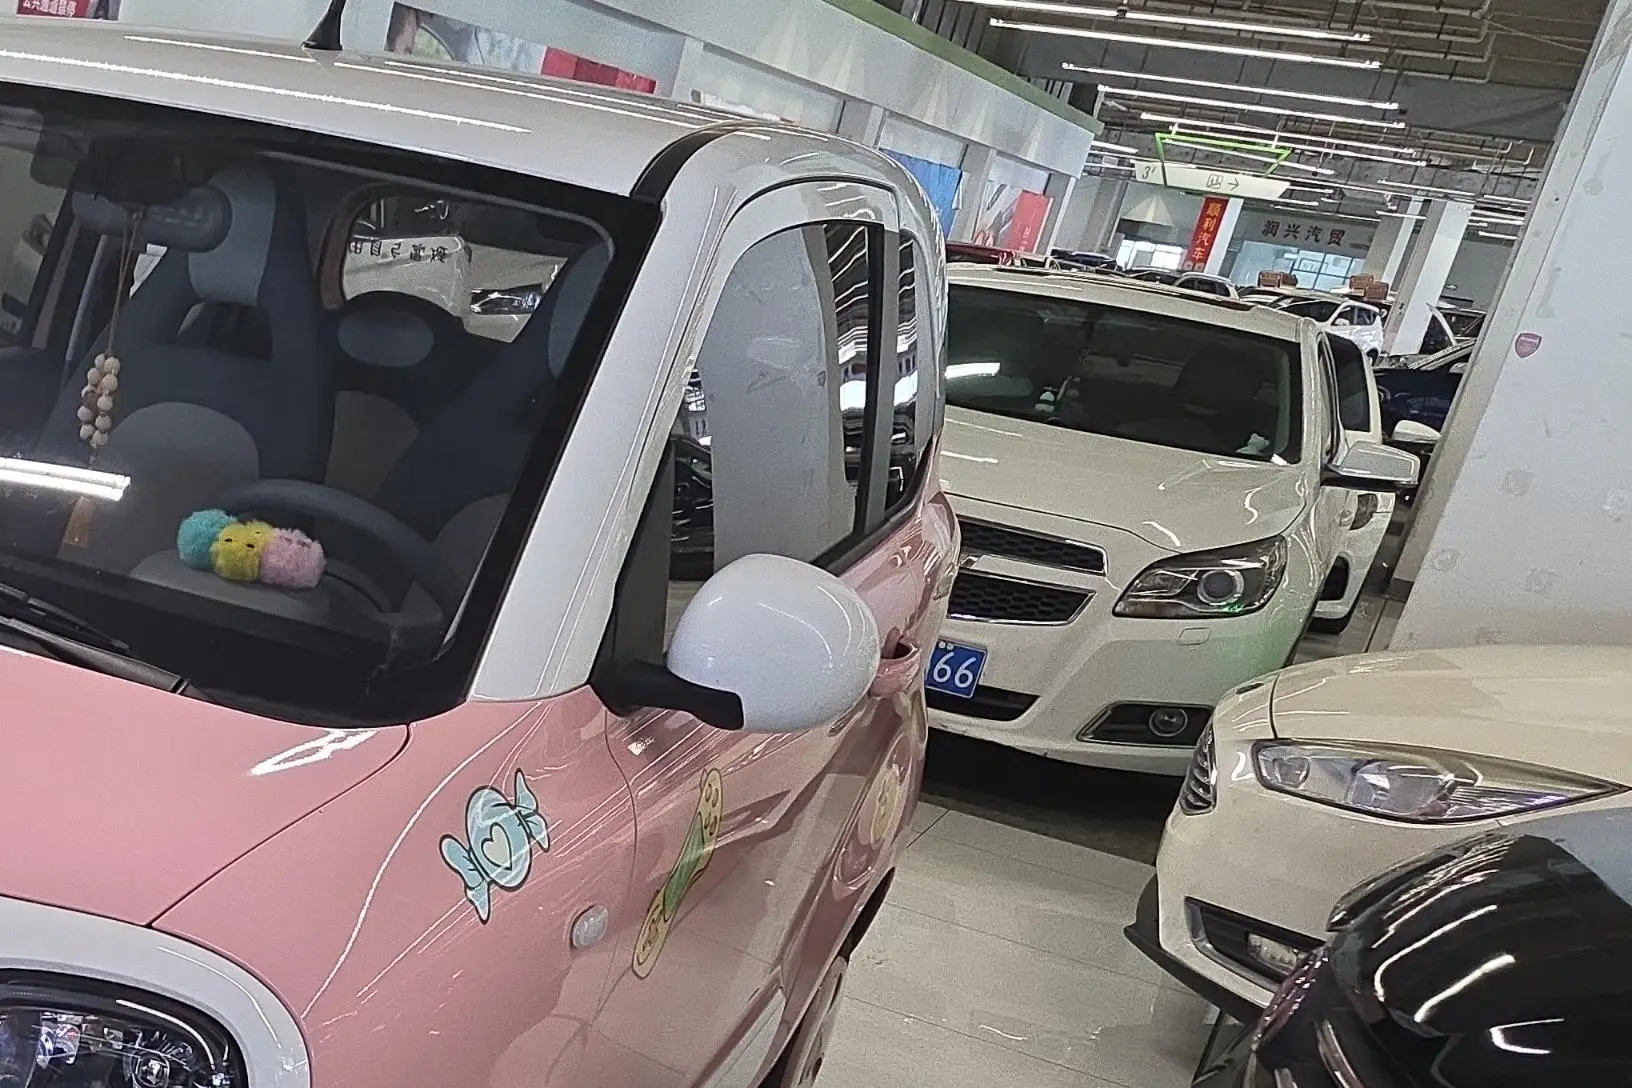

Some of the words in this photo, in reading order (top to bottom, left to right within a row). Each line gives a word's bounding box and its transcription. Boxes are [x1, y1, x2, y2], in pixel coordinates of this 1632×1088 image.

[1262, 220, 1345, 246] 润兴汽贸
[933, 651, 976, 688] 66
